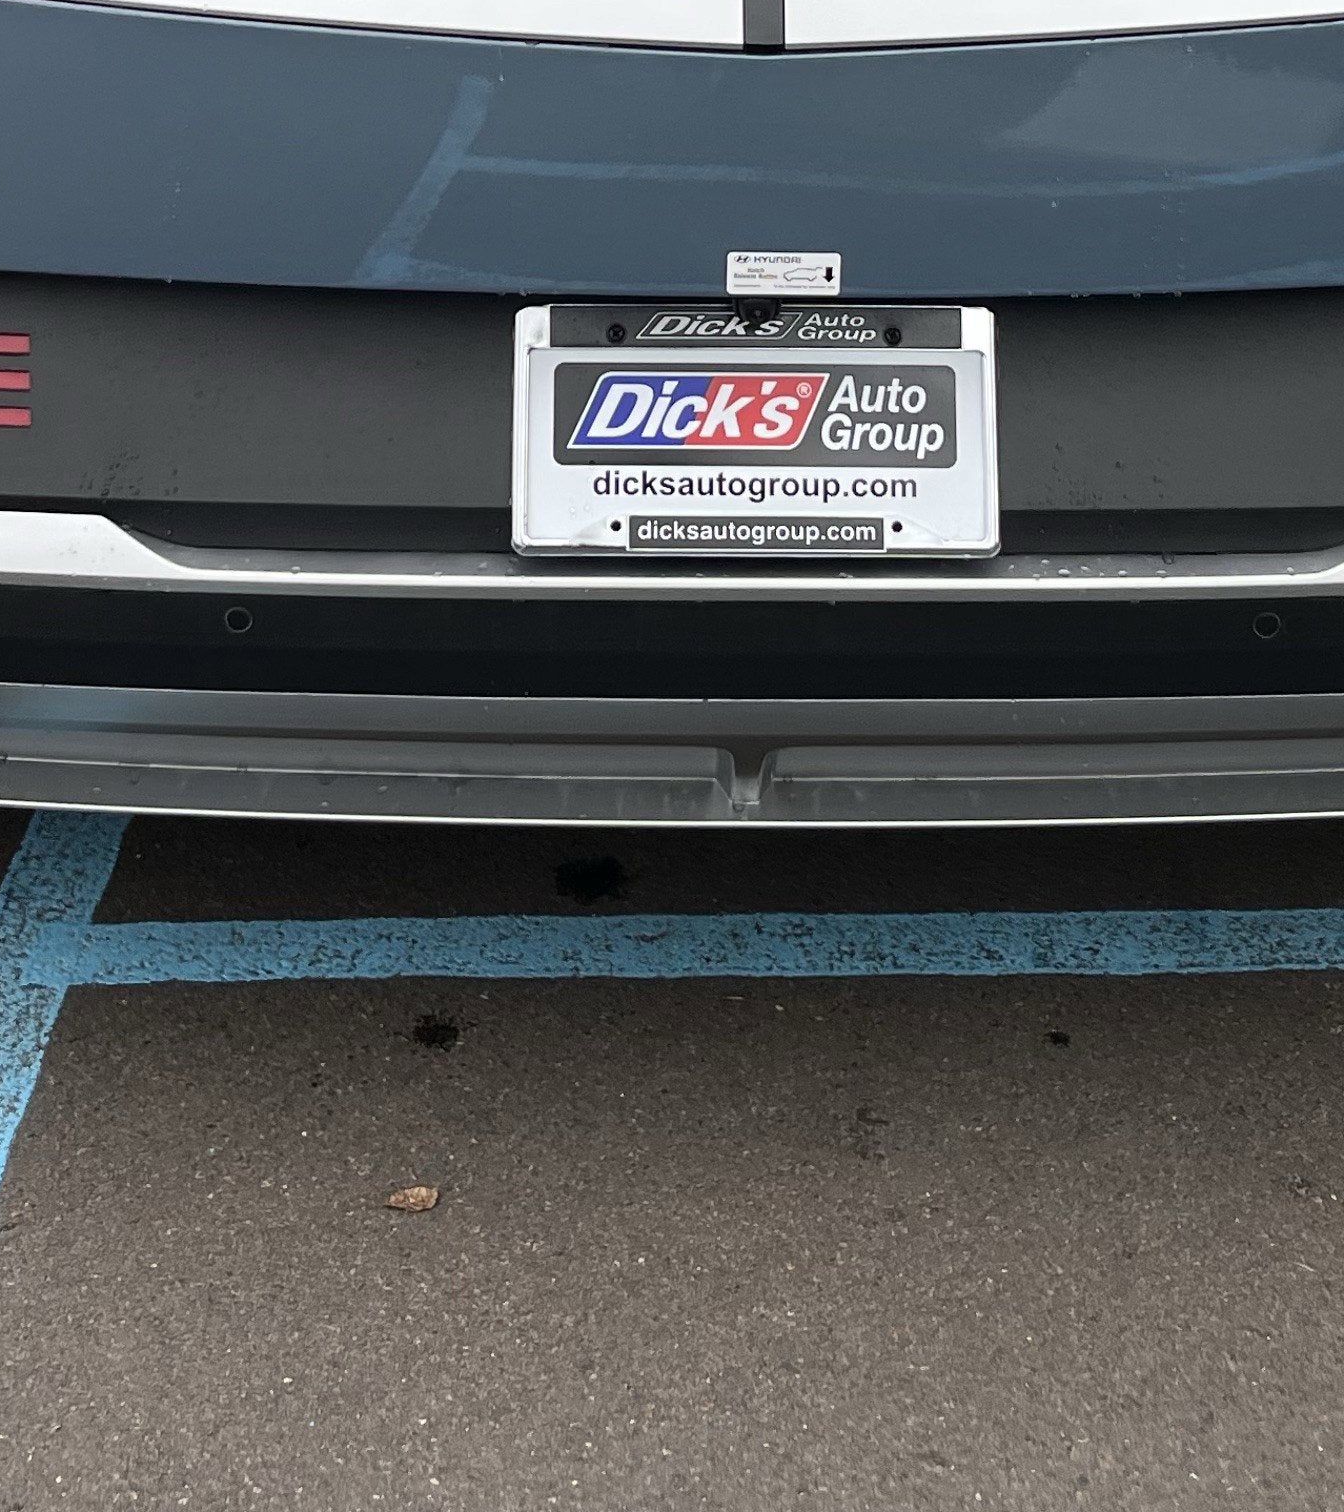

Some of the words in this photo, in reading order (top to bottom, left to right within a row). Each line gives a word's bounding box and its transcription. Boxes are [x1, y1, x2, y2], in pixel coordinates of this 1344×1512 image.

[753, 255, 802, 264] HYUNDAI
[649, 315, 785, 336] Dicks
[804, 312, 865, 327] Auto
[797, 326, 877, 343] Group
[827, 374, 927, 413] Auto
[586, 380, 800, 439] Dick's
[820, 412, 945, 460] Group
[593, 470, 917, 504] dicksautogroup.com
[637, 520, 876, 545] dicksautogroup.com
